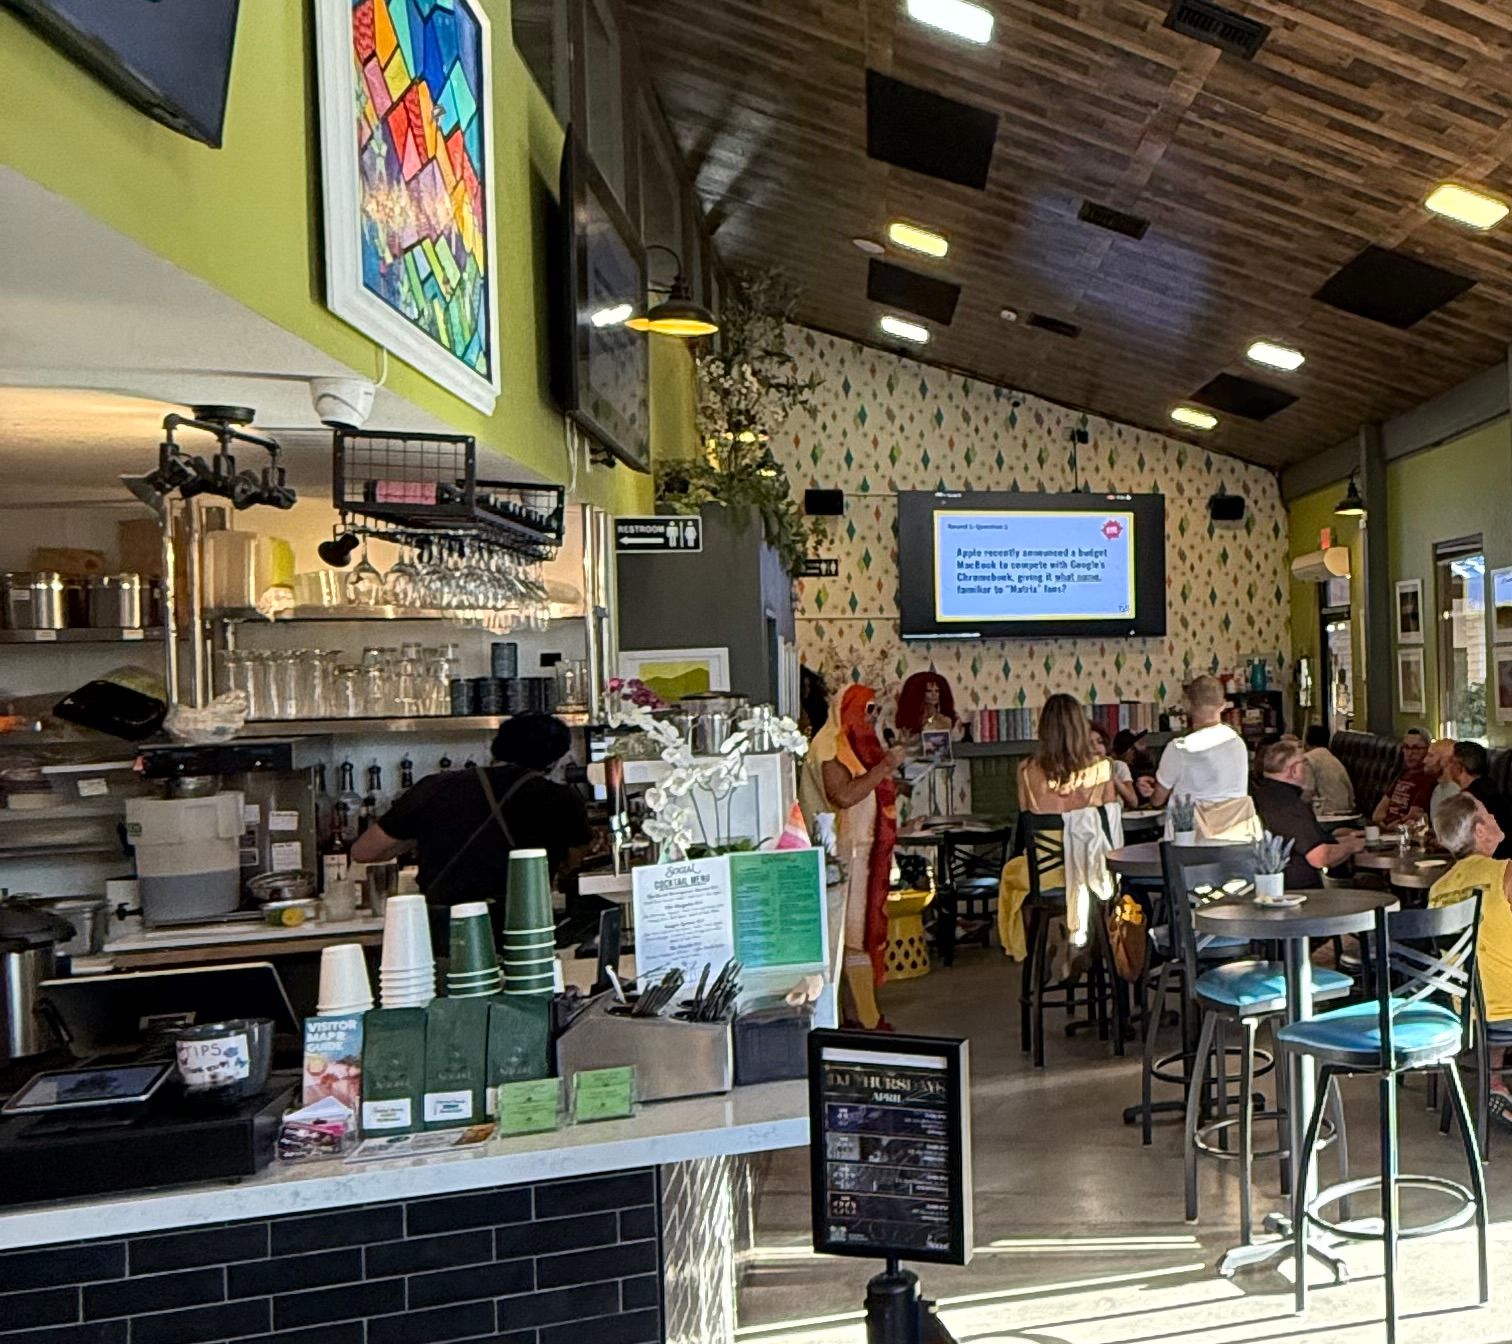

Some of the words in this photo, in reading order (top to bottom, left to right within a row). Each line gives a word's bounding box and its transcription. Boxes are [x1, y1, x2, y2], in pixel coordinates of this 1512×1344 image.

[618, 525, 664, 534] RESTROOM
[957, 548, 981, 559] Apple
[984, 548, 1019, 559] recently
[1022, 548, 1068, 557] announced
[1078, 548, 1107, 559] budget
[957, 560, 996, 569] MacBook
[999, 560, 1008, 569] to
[1011, 561, 1047, 571] compete
[1050, 561, 1067, 569] with
[1070, 560, 1105, 571] Google's
[957, 572, 1014, 582] Chromebook,
[1018, 574, 1042, 583] giving
[1046, 572, 1052, 581] it
[1055, 572, 1075, 582] what
[957, 585, 991, 594] familiar
[994, 586, 1003, 594] to
[1043, 584, 1067, 594] fans?
[654, 878, 689, 890] COCKTAIL
[691, 874, 711, 885] MENU
[307, 1020, 357, 1032] VISITOR
[306, 1032, 336, 1042] MAP
[181, 1043, 222, 1056] TIPS
[306, 1042, 344, 1052] GUIDE
[831, 1074, 850, 1086] DJ
[872, 1092, 902, 1103] APRIL
